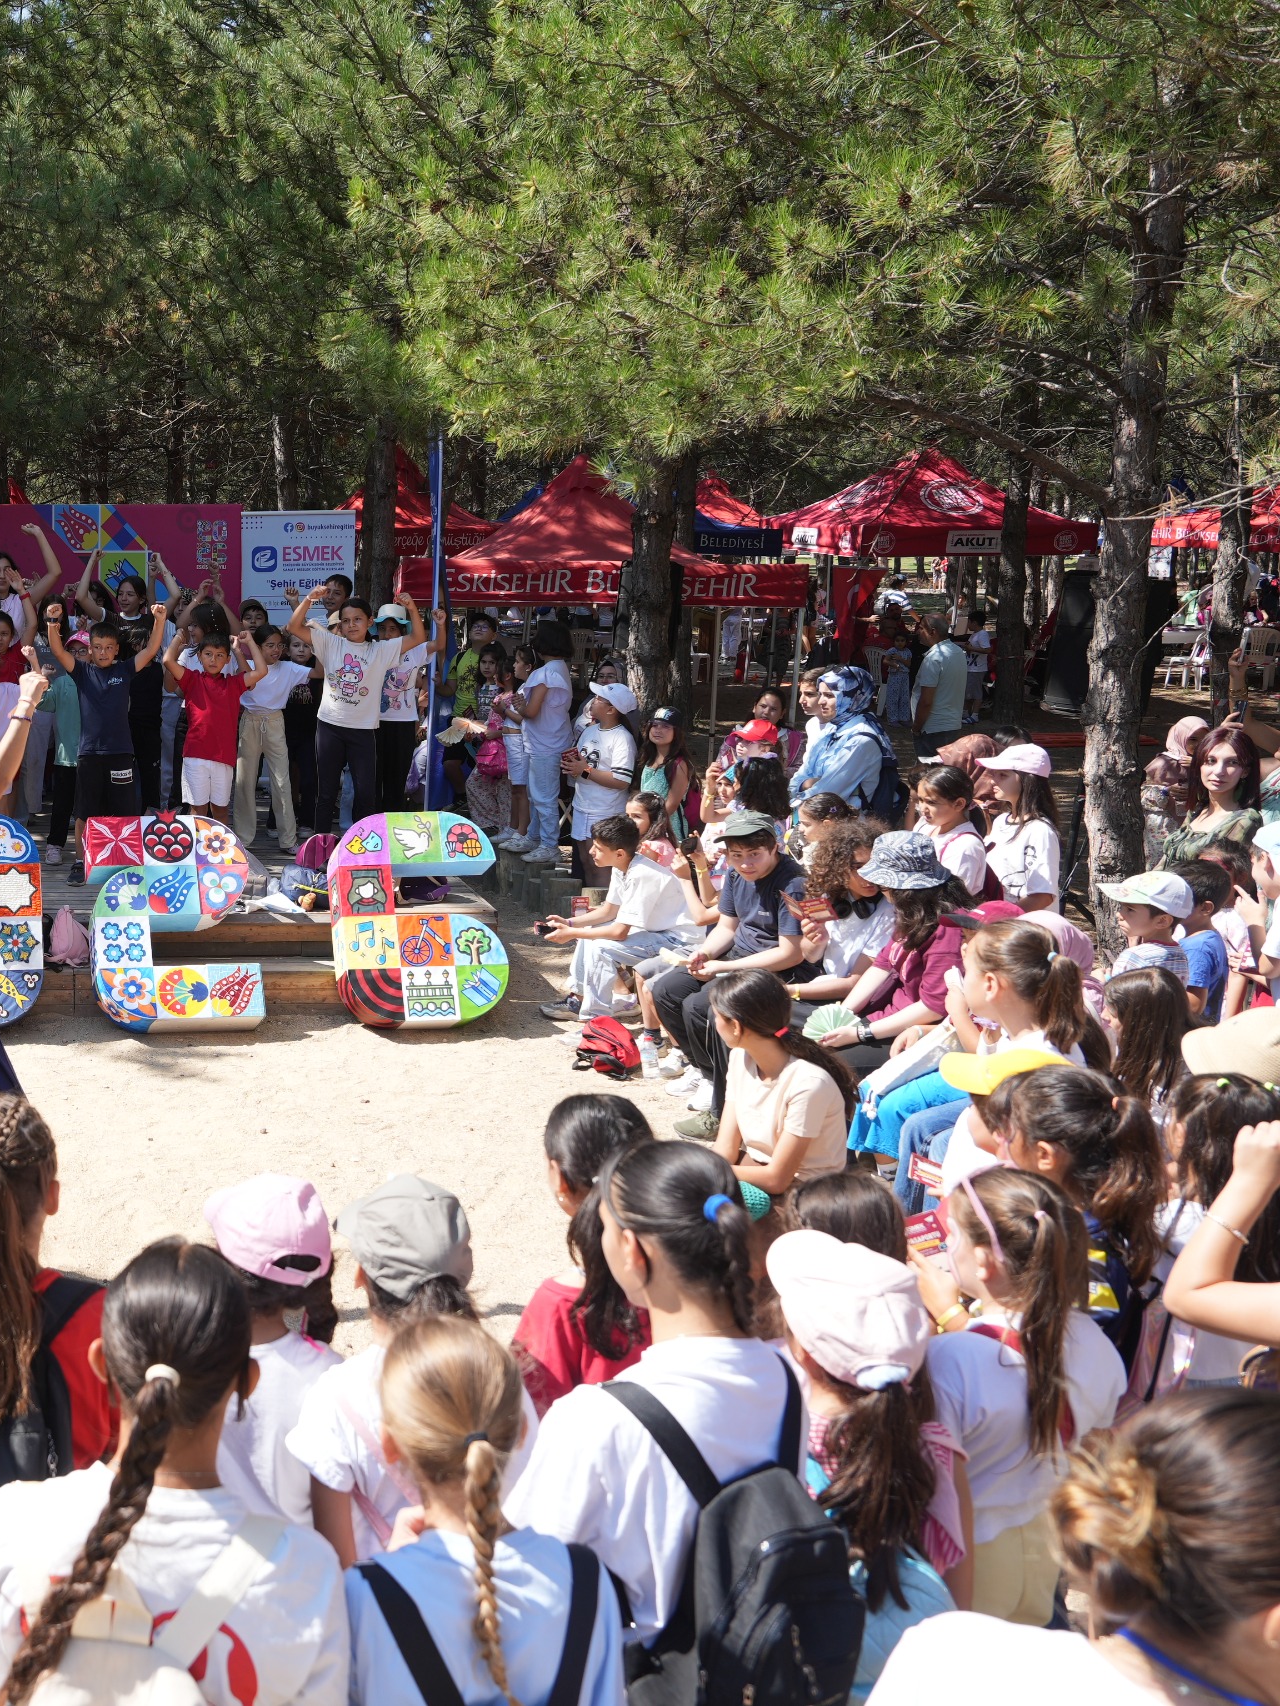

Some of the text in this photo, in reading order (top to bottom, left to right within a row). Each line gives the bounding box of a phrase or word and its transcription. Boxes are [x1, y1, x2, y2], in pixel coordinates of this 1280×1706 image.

[394, 532, 424, 551] erçeğe
[700, 534, 765, 549] BELEDİYESİ
[954, 537, 995, 547] AKUT
[282, 545, 344, 562] ESMEK
